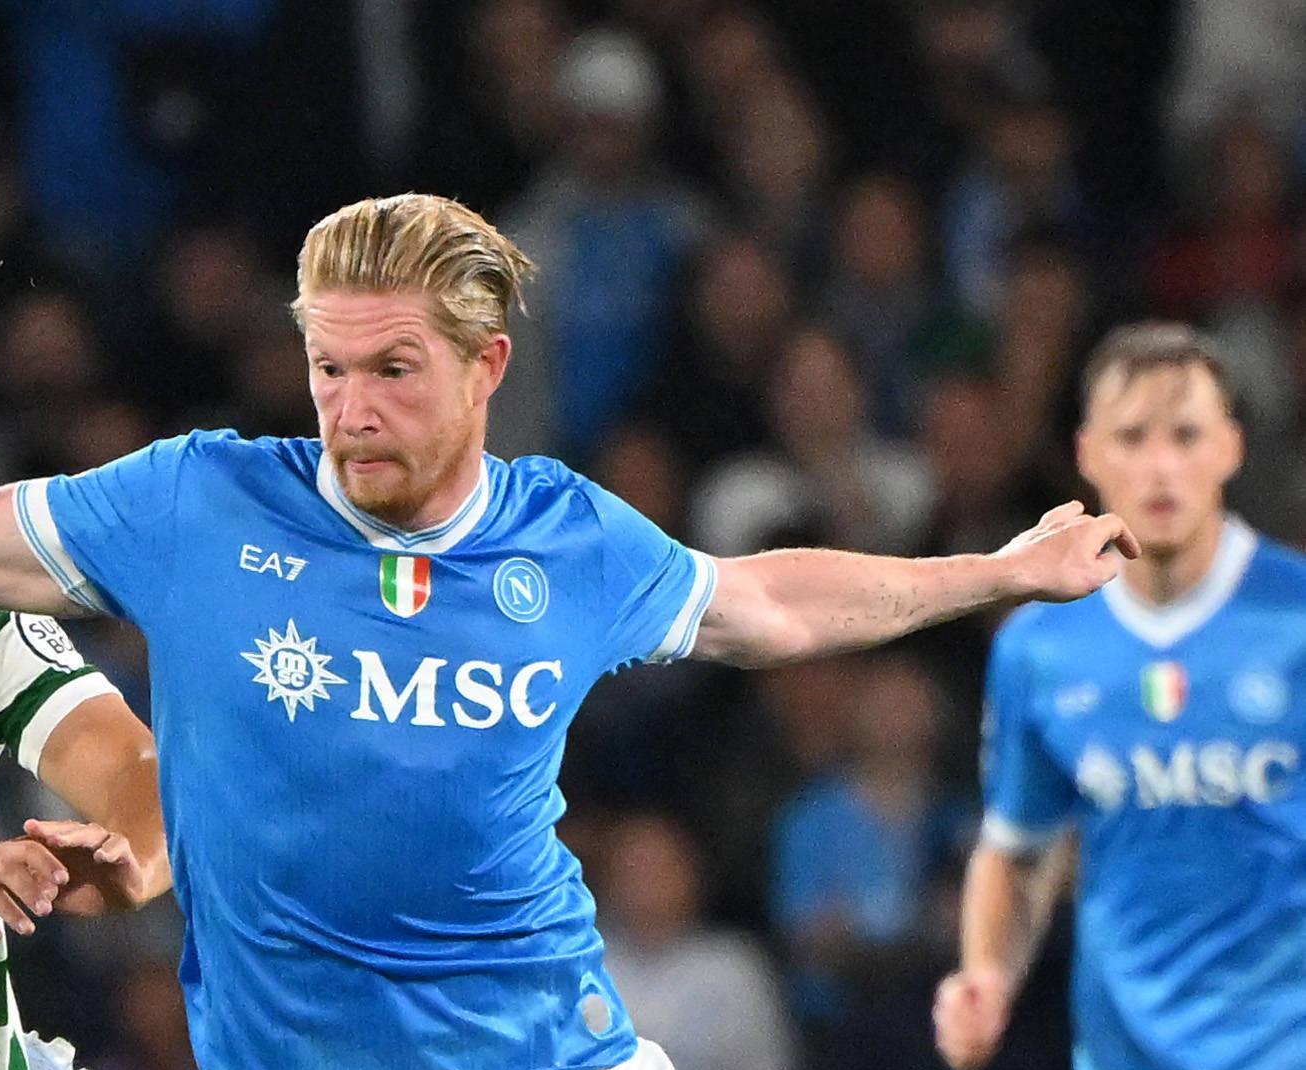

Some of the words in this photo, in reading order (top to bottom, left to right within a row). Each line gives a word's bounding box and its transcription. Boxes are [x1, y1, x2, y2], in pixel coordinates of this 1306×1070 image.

[239, 544, 310, 581] EA7
[508, 576, 534, 606] N
[350, 650, 564, 729] MSC
[1131, 740, 1300, 809] MSC
